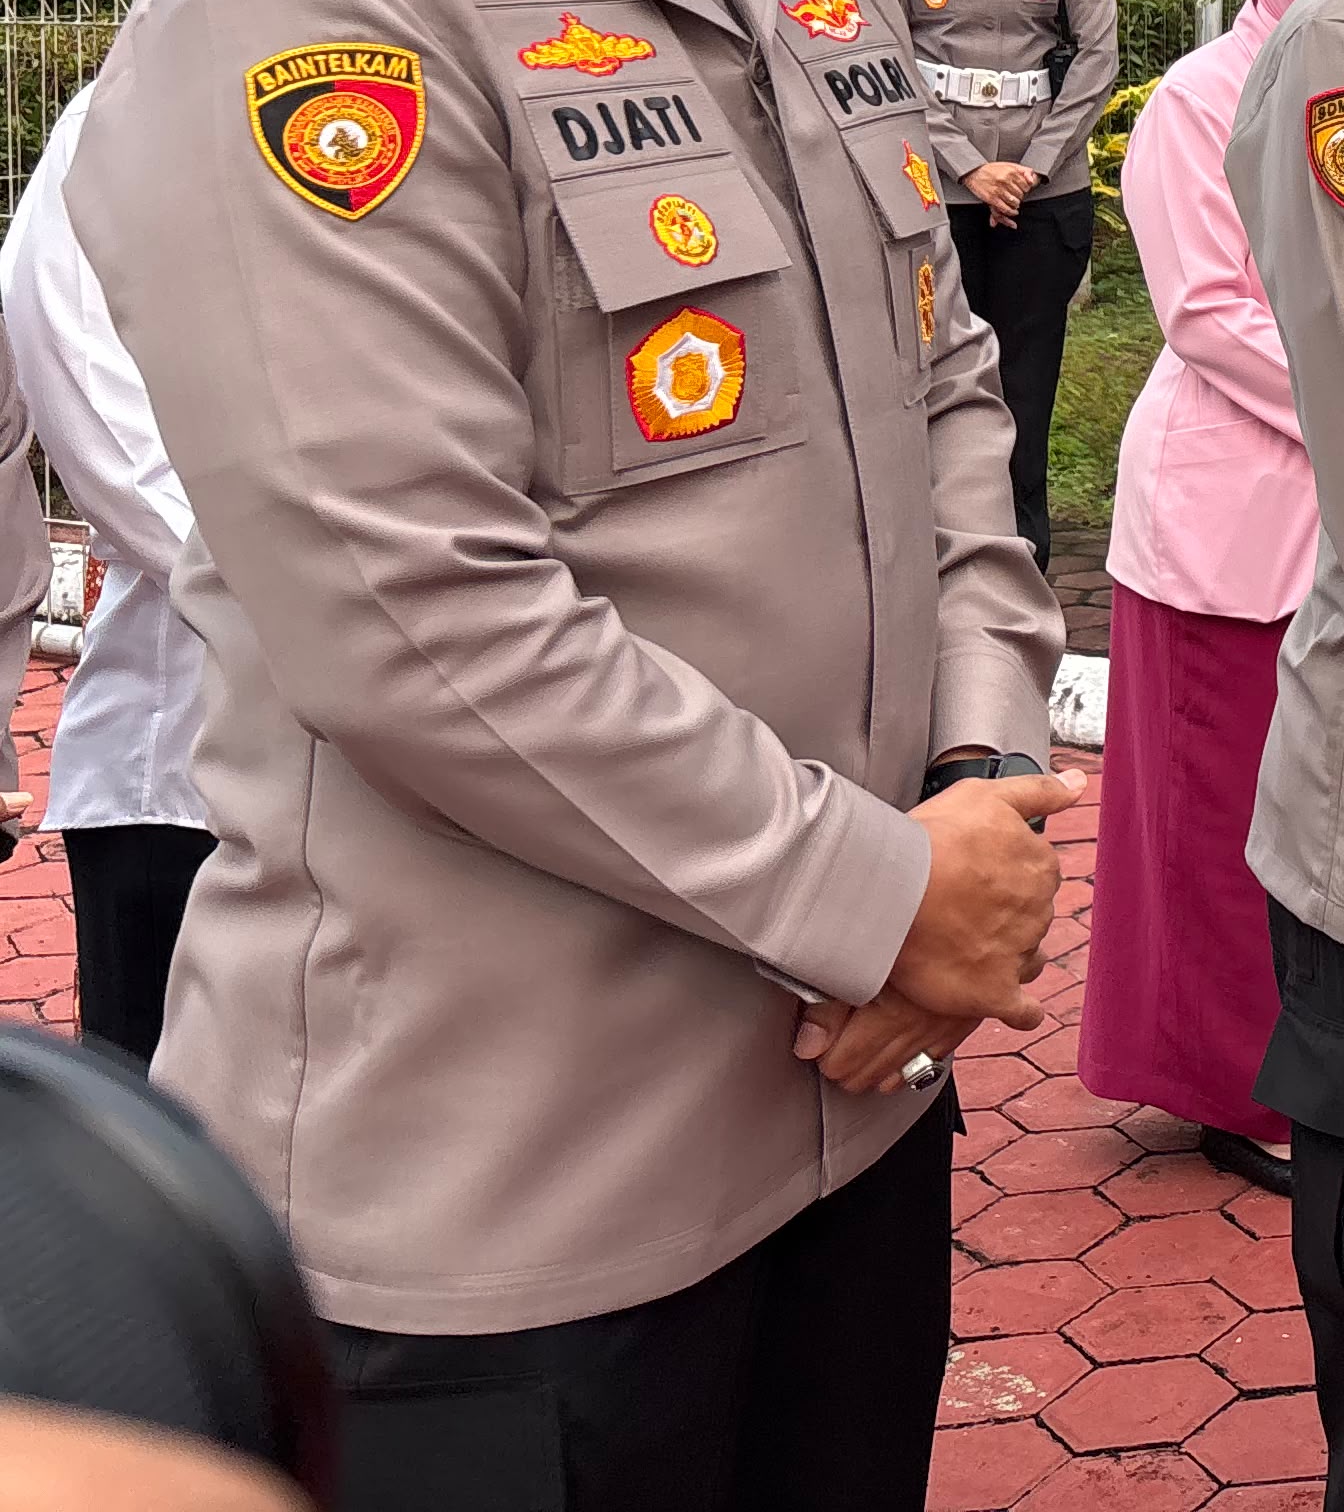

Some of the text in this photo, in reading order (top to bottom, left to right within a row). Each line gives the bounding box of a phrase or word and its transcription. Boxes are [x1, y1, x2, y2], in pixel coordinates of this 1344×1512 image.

[256, 52, 408, 92] BAINTELKAM
[824, 56, 917, 115] POLRI
[551, 94, 703, 161] DJATI
